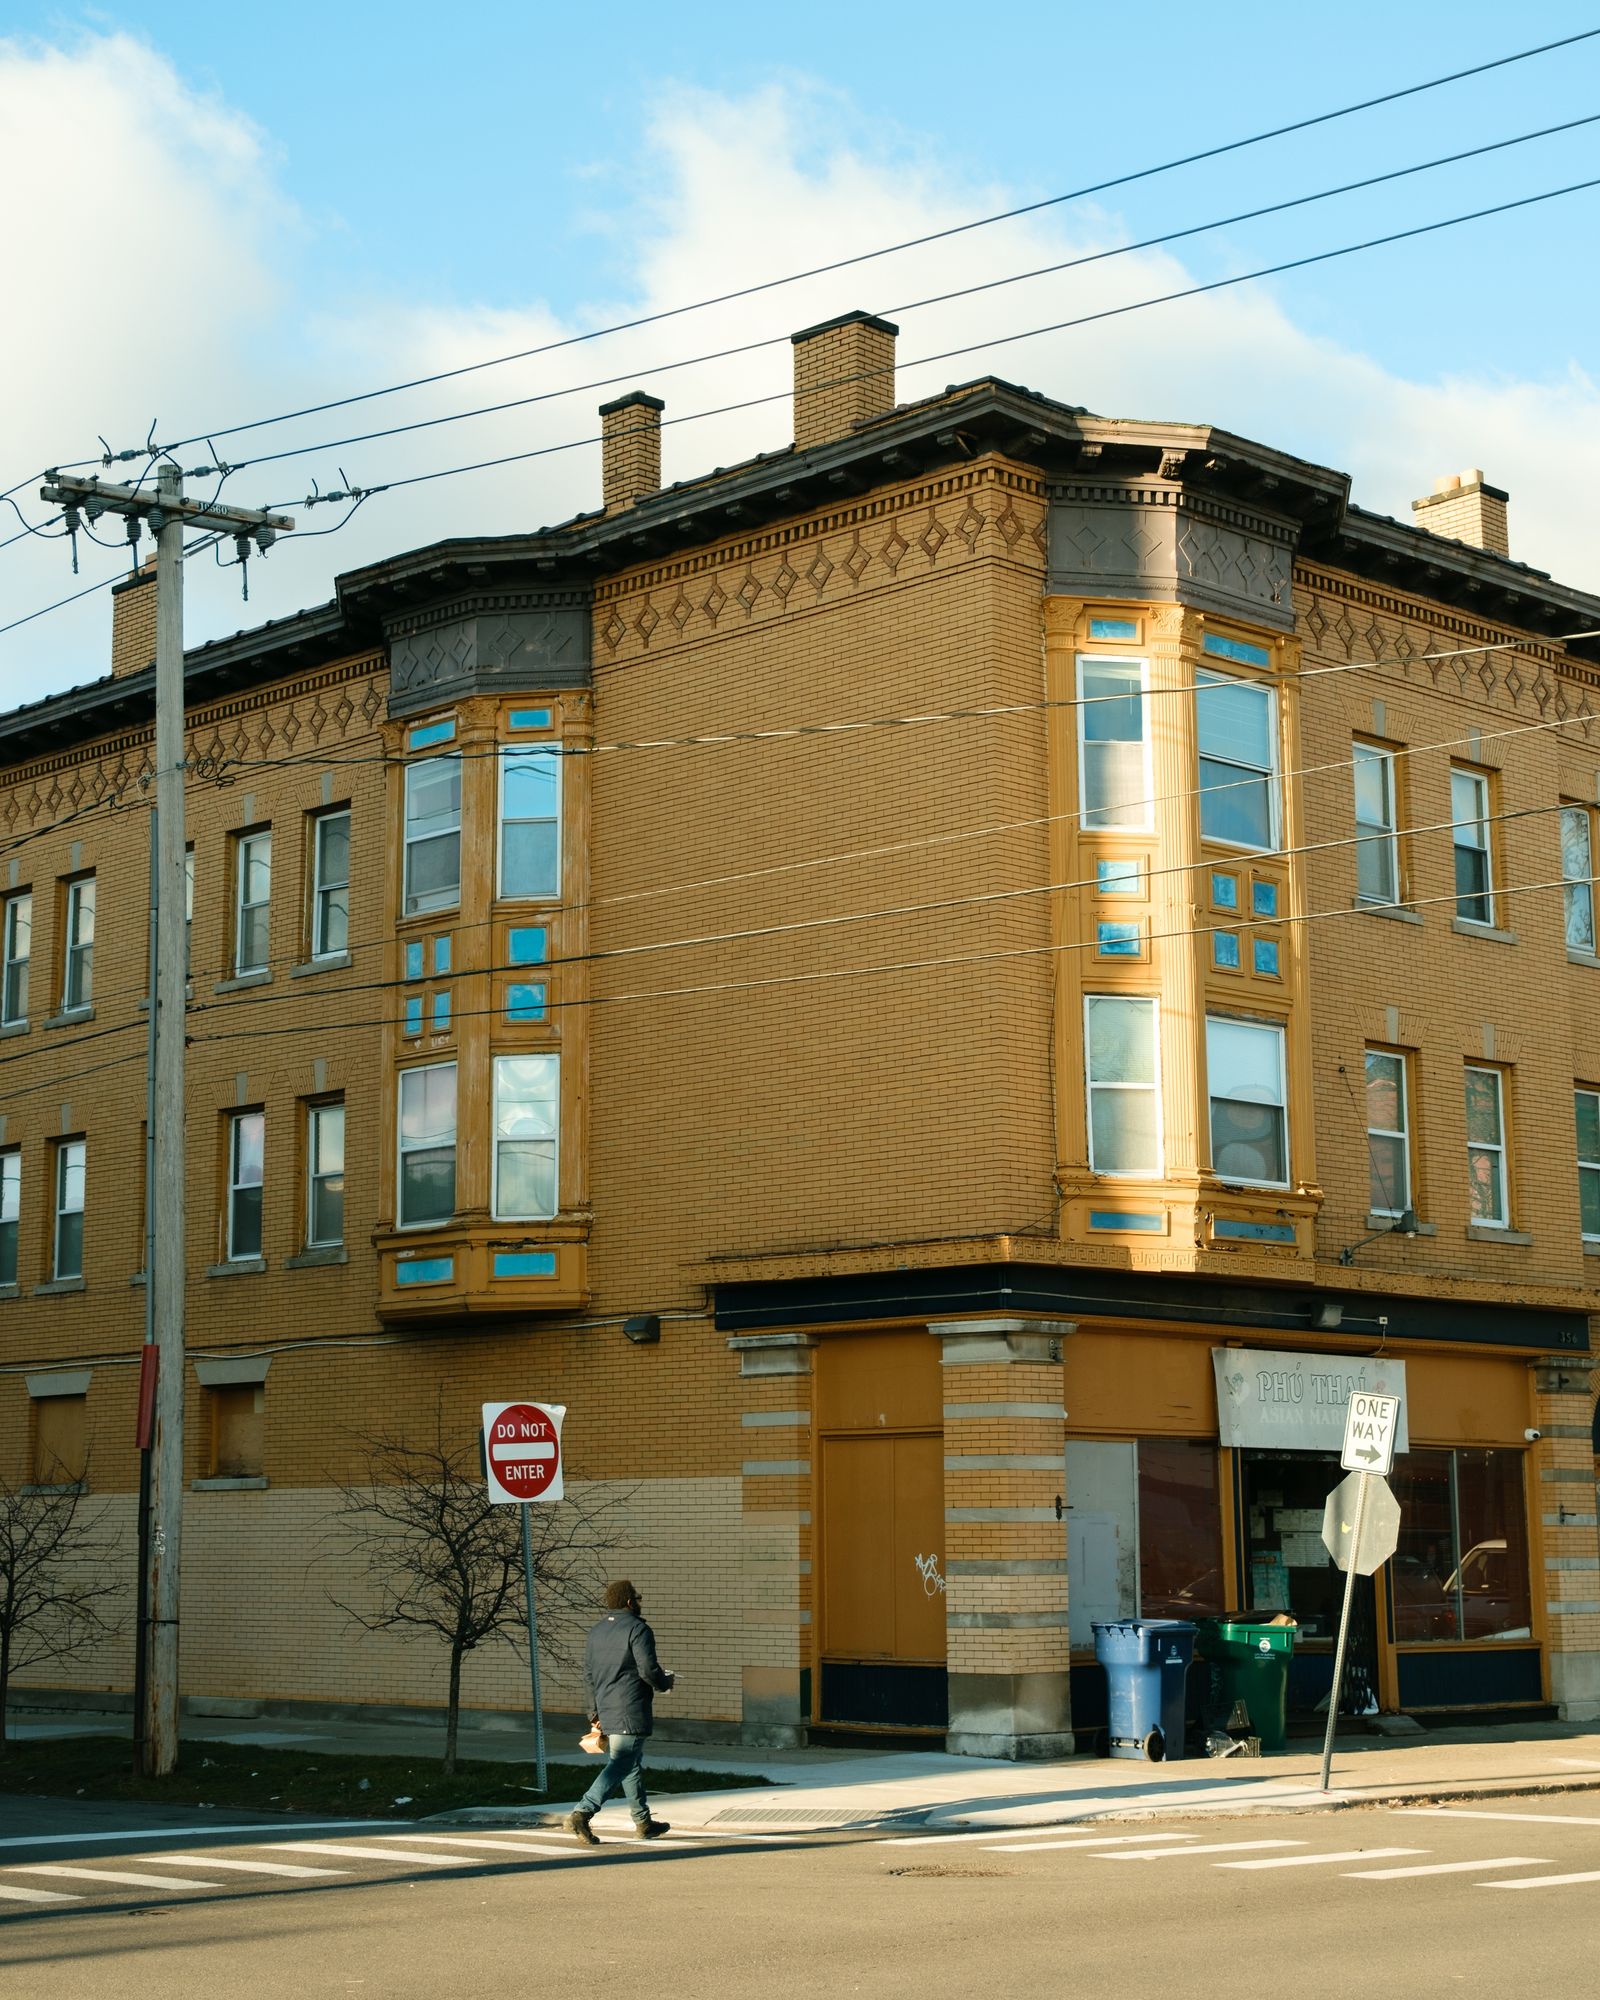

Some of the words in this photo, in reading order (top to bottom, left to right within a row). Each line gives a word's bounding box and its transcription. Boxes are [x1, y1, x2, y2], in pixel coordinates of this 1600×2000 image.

[1260, 1406, 1304, 1424] ASIAN
[1356, 1398, 1390, 1419] ONE
[497, 1424, 515, 1438] DO
[520, 1423, 547, 1438] NOT
[1352, 1421, 1388, 1442] WAY
[505, 1464, 545, 1481] ENTER
